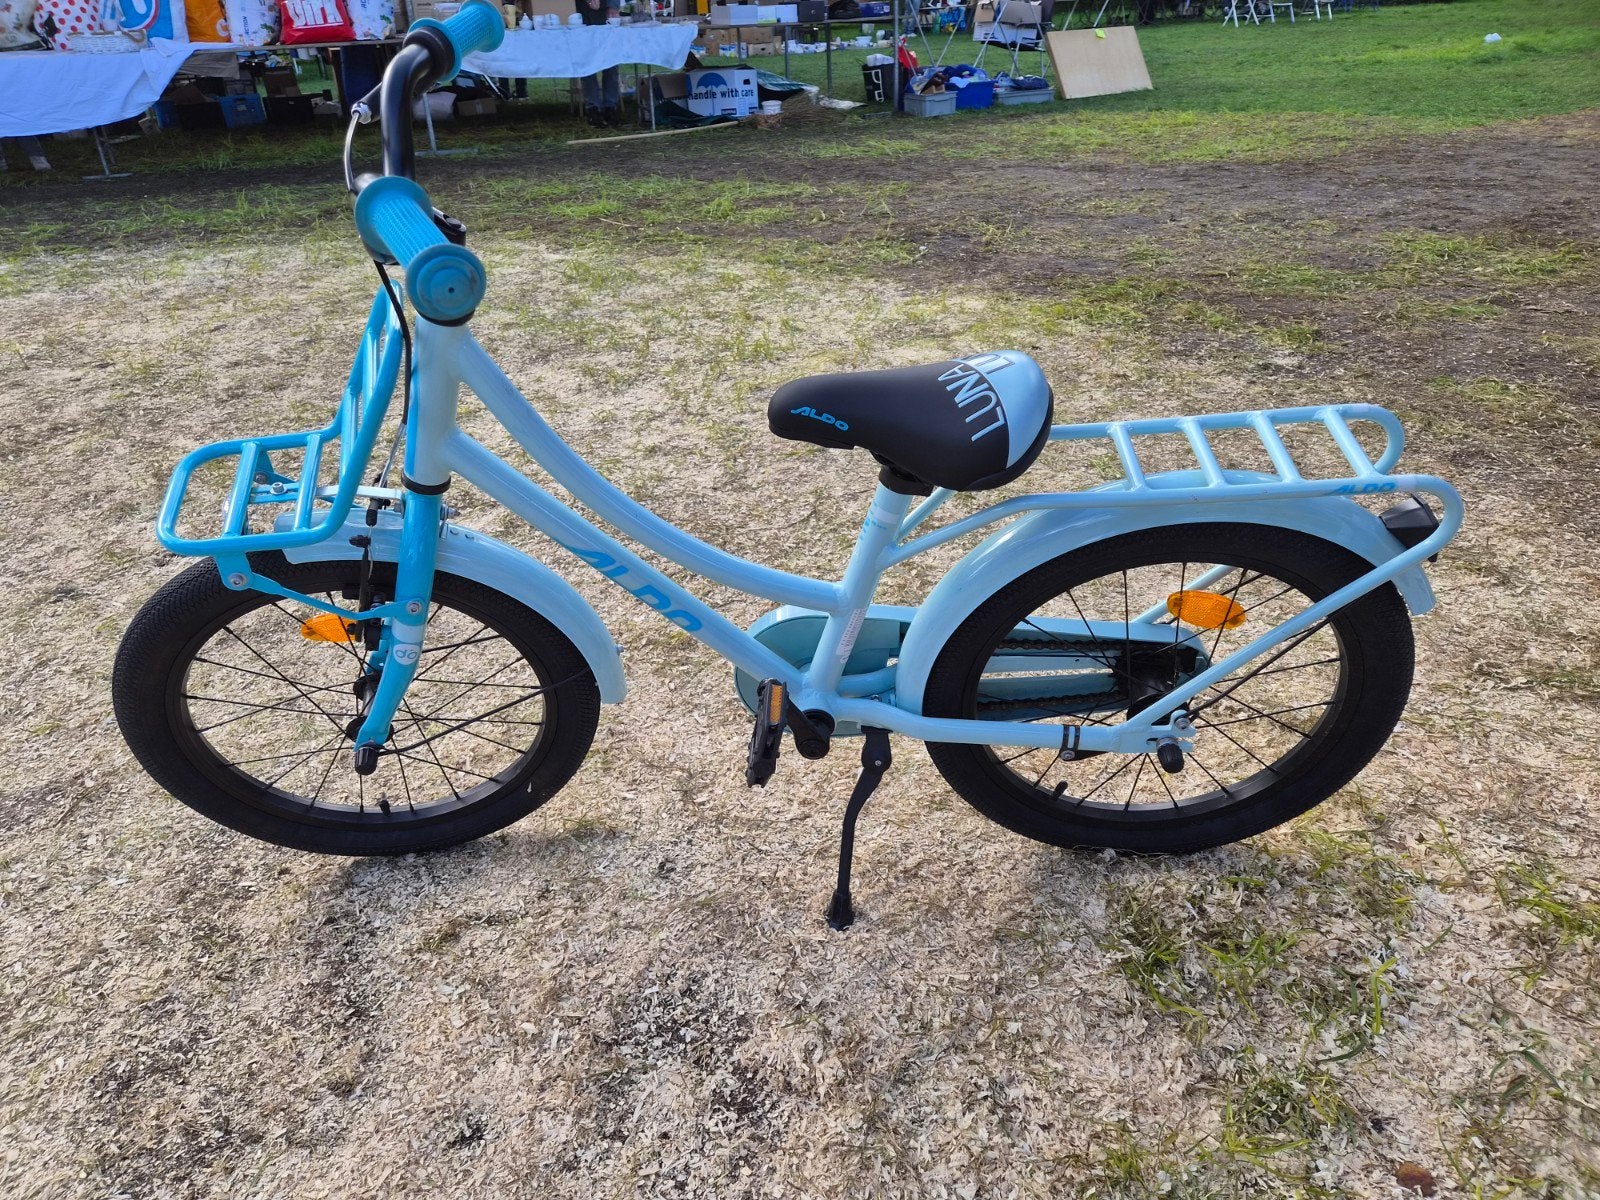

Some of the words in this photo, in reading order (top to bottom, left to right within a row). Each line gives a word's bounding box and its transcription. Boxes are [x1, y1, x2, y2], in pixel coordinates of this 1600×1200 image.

[720, 88, 740, 99] with
[741, 89, 754, 97] care
[938, 363, 1006, 442] LUNA
[790, 406, 849, 431] ALDO
[1331, 482, 1396, 494] ALDO
[562, 545, 703, 632] ALDO
